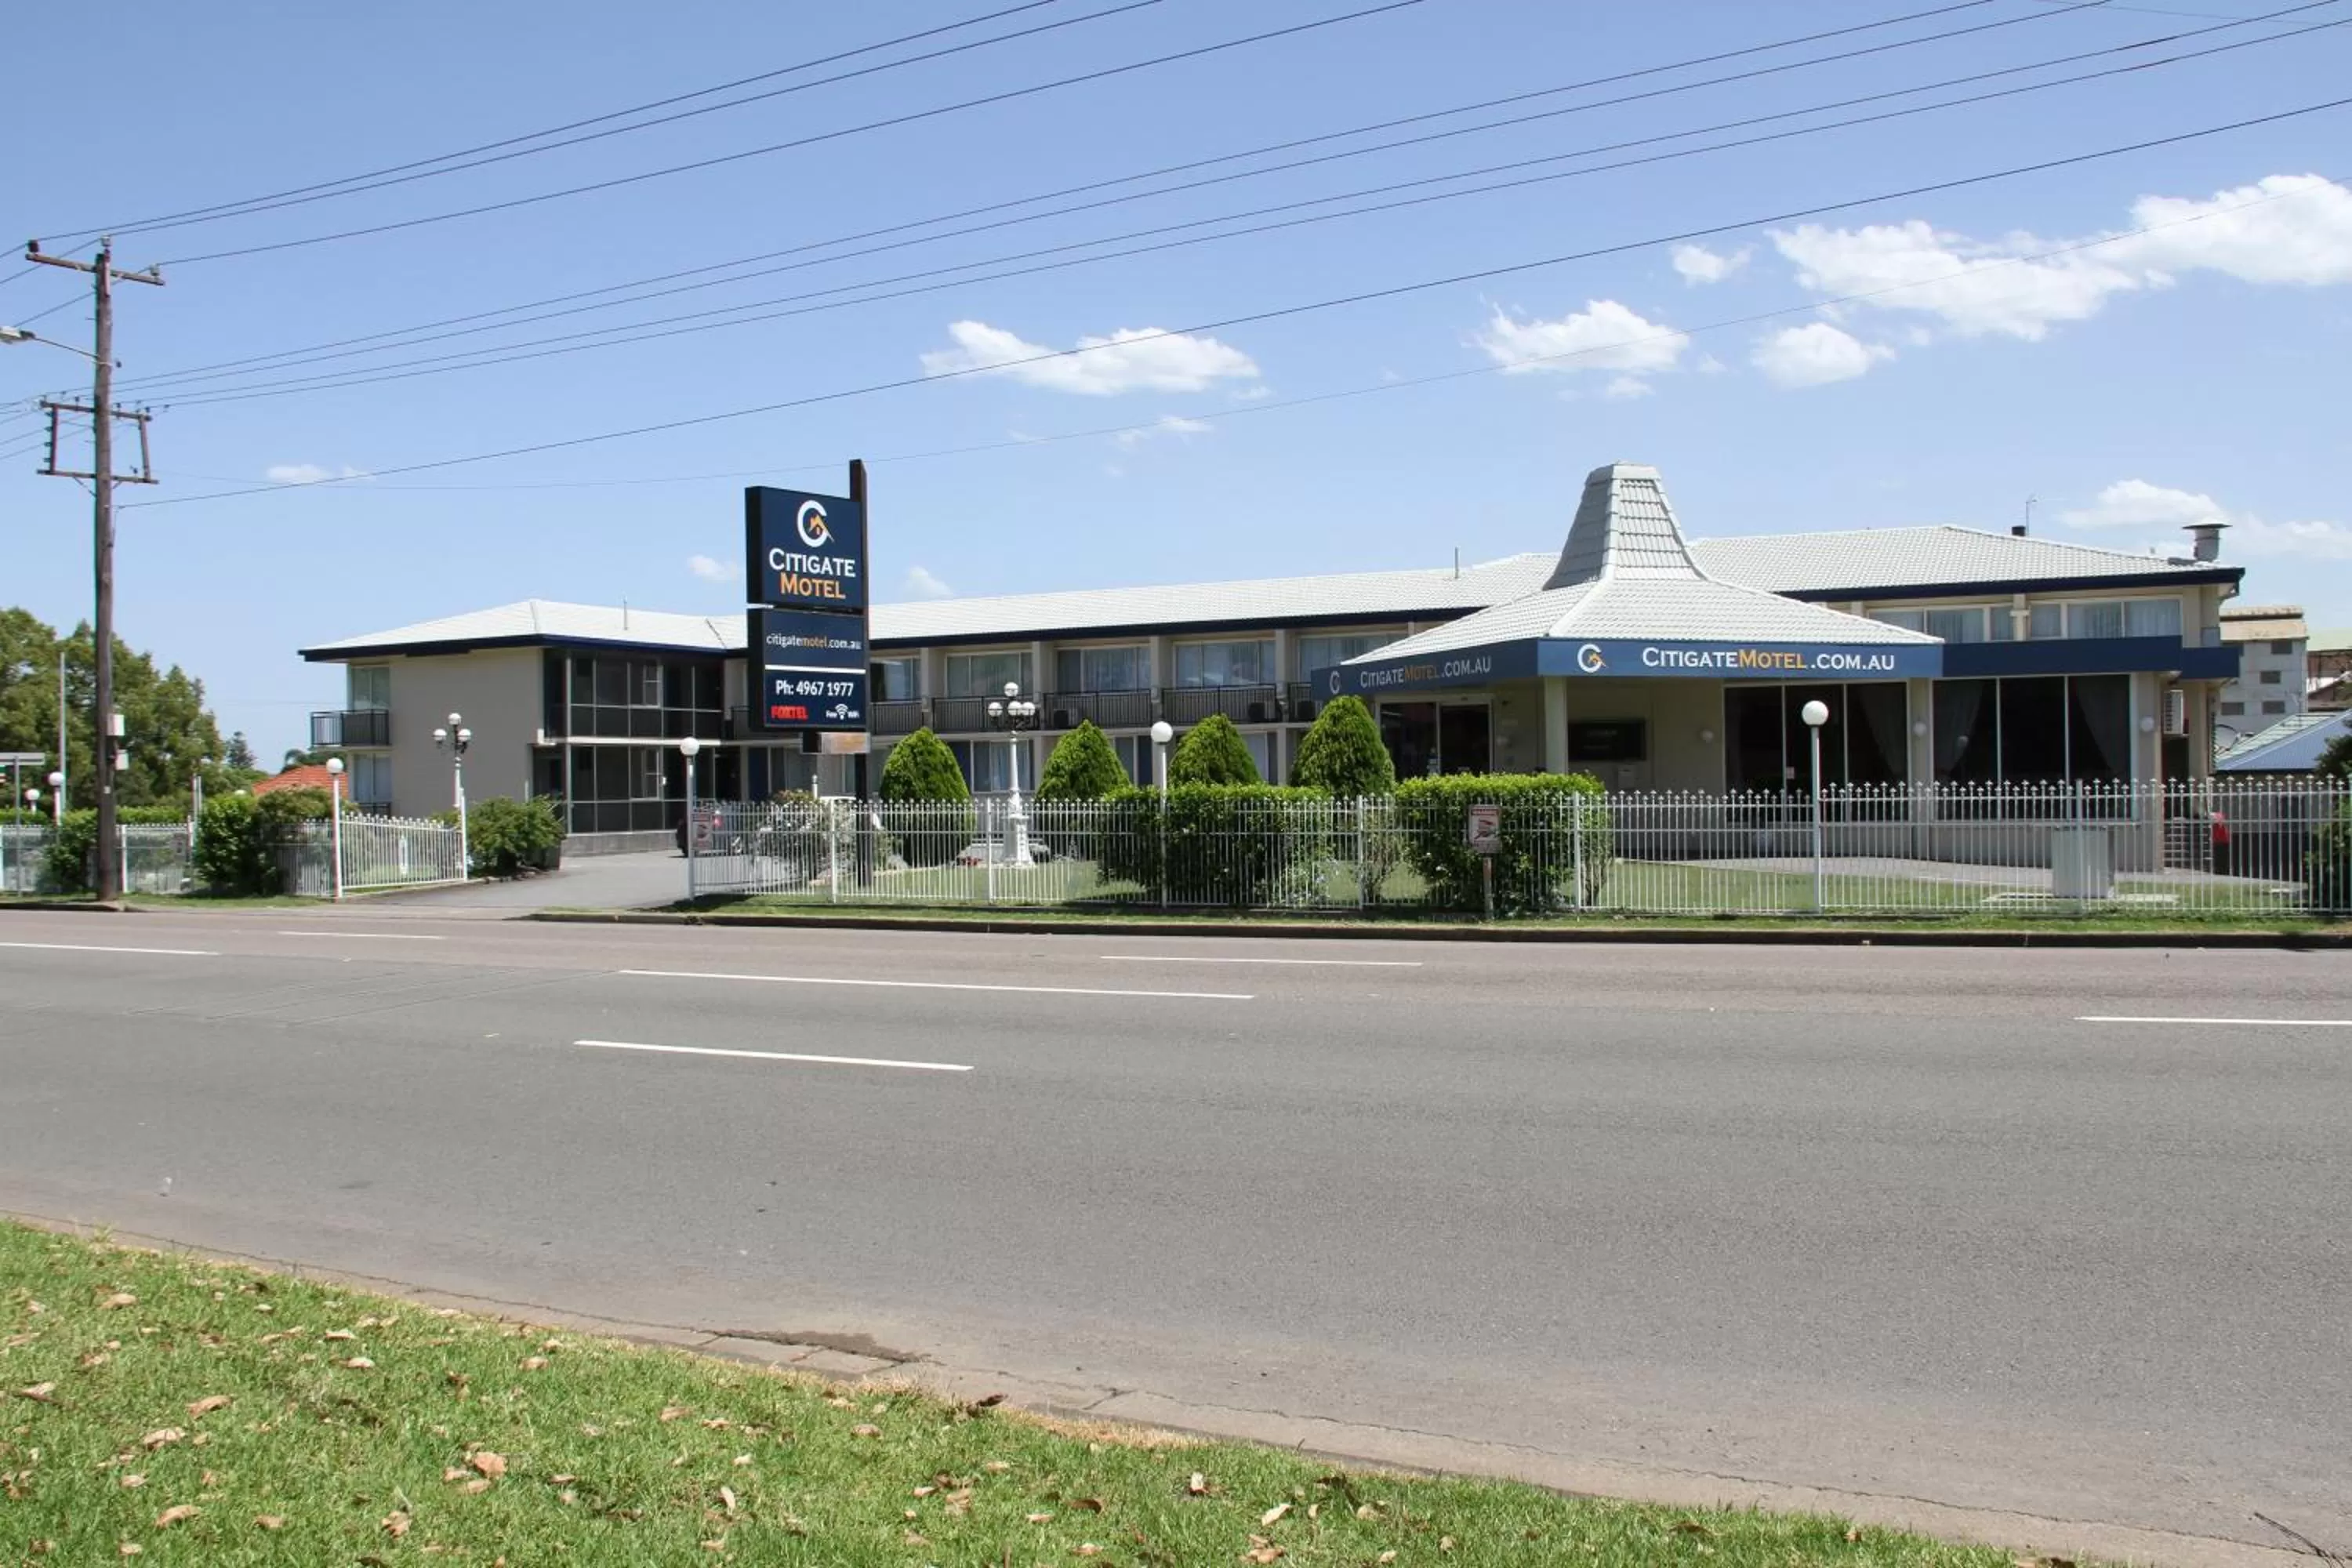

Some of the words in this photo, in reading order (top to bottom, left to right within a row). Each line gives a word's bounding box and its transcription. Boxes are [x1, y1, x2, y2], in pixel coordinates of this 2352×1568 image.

[769, 547, 855, 577] CITIGATE
[779, 572, 846, 598] MOTEL
[766, 633, 862, 650] citigatemotel.com.au
[775, 679, 794, 695] Ph:
[796, 680, 825, 696] 4967
[827, 681, 854, 697] 1977
